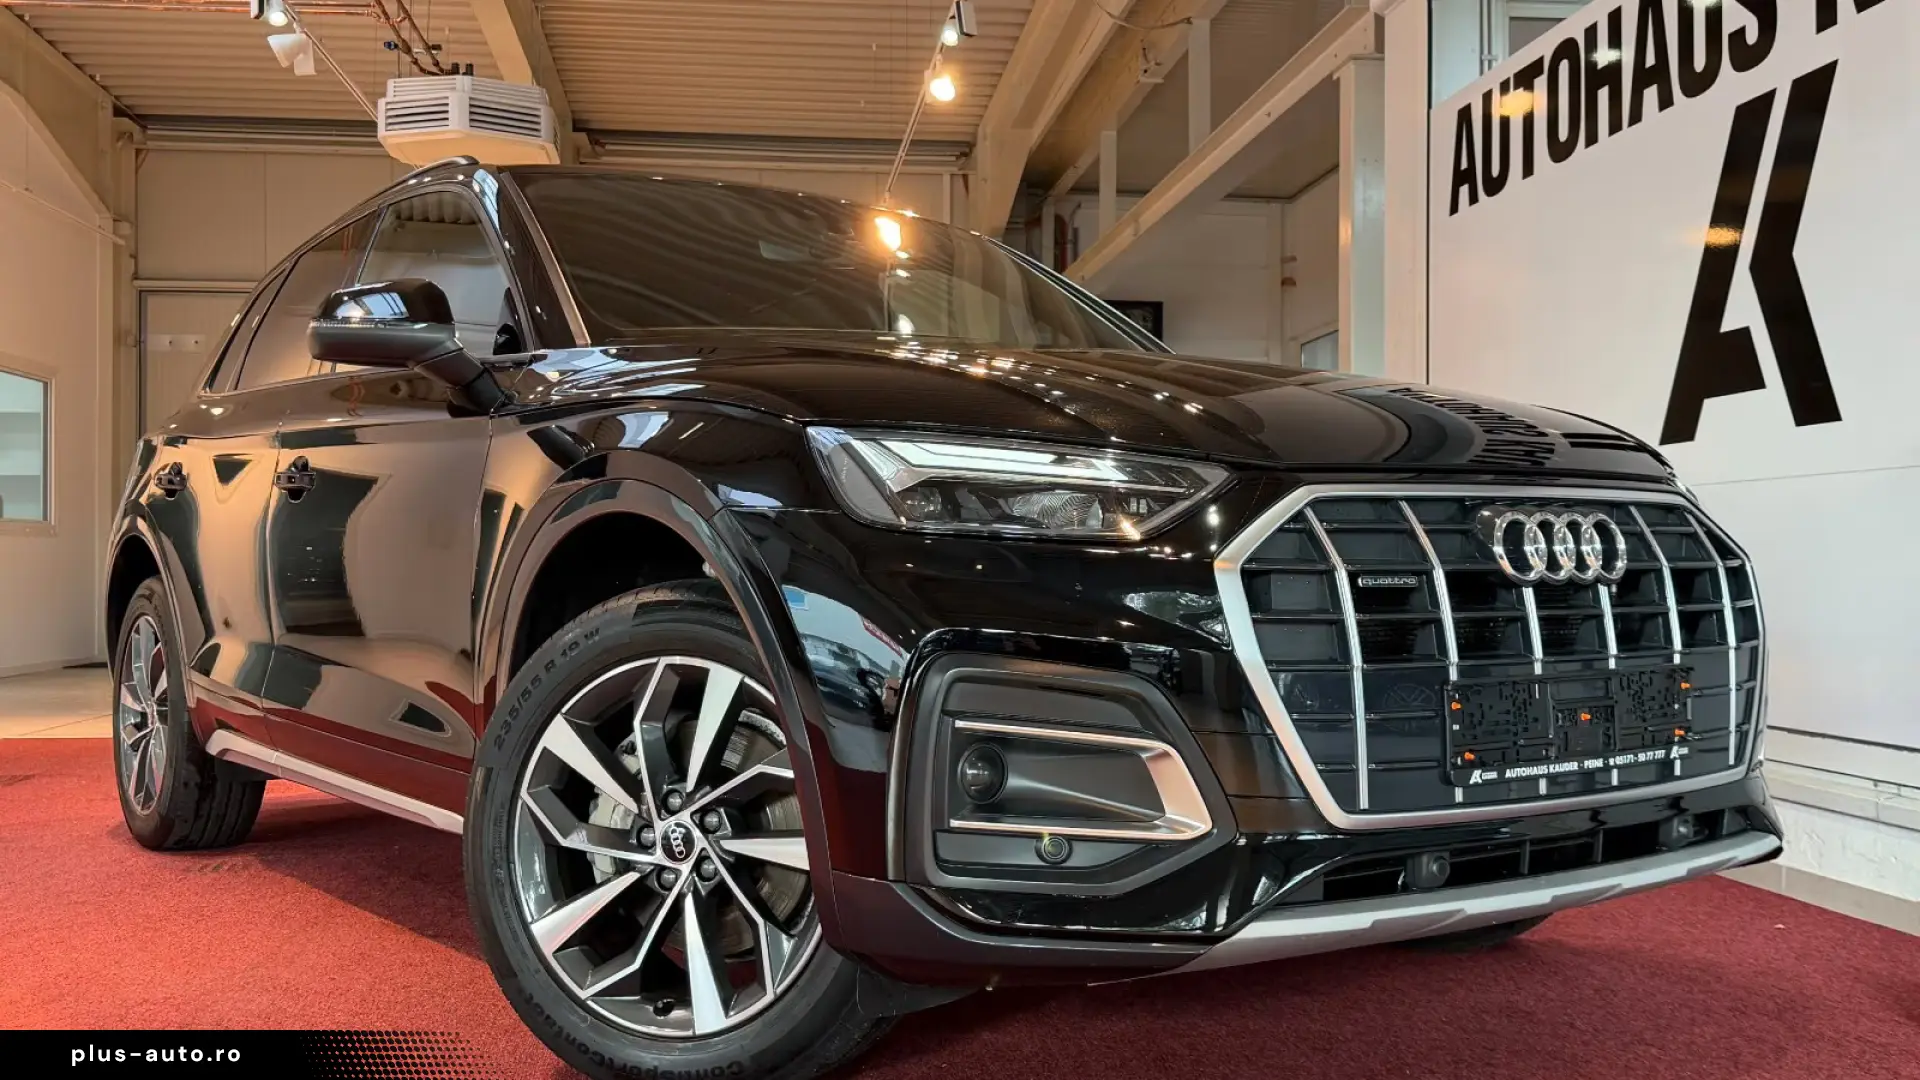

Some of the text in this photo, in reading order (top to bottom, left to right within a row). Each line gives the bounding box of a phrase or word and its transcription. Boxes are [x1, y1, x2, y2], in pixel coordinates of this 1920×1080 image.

[1362, 576, 1416, 586] quattro
[494, 674, 542, 752] 235/55
[543, 659, 557, 674] R
[1505, 764, 1548, 778] AUTOHAUS
[1549, 761, 1579, 773] KAUDER
[1584, 758, 1604, 769] PEINE
